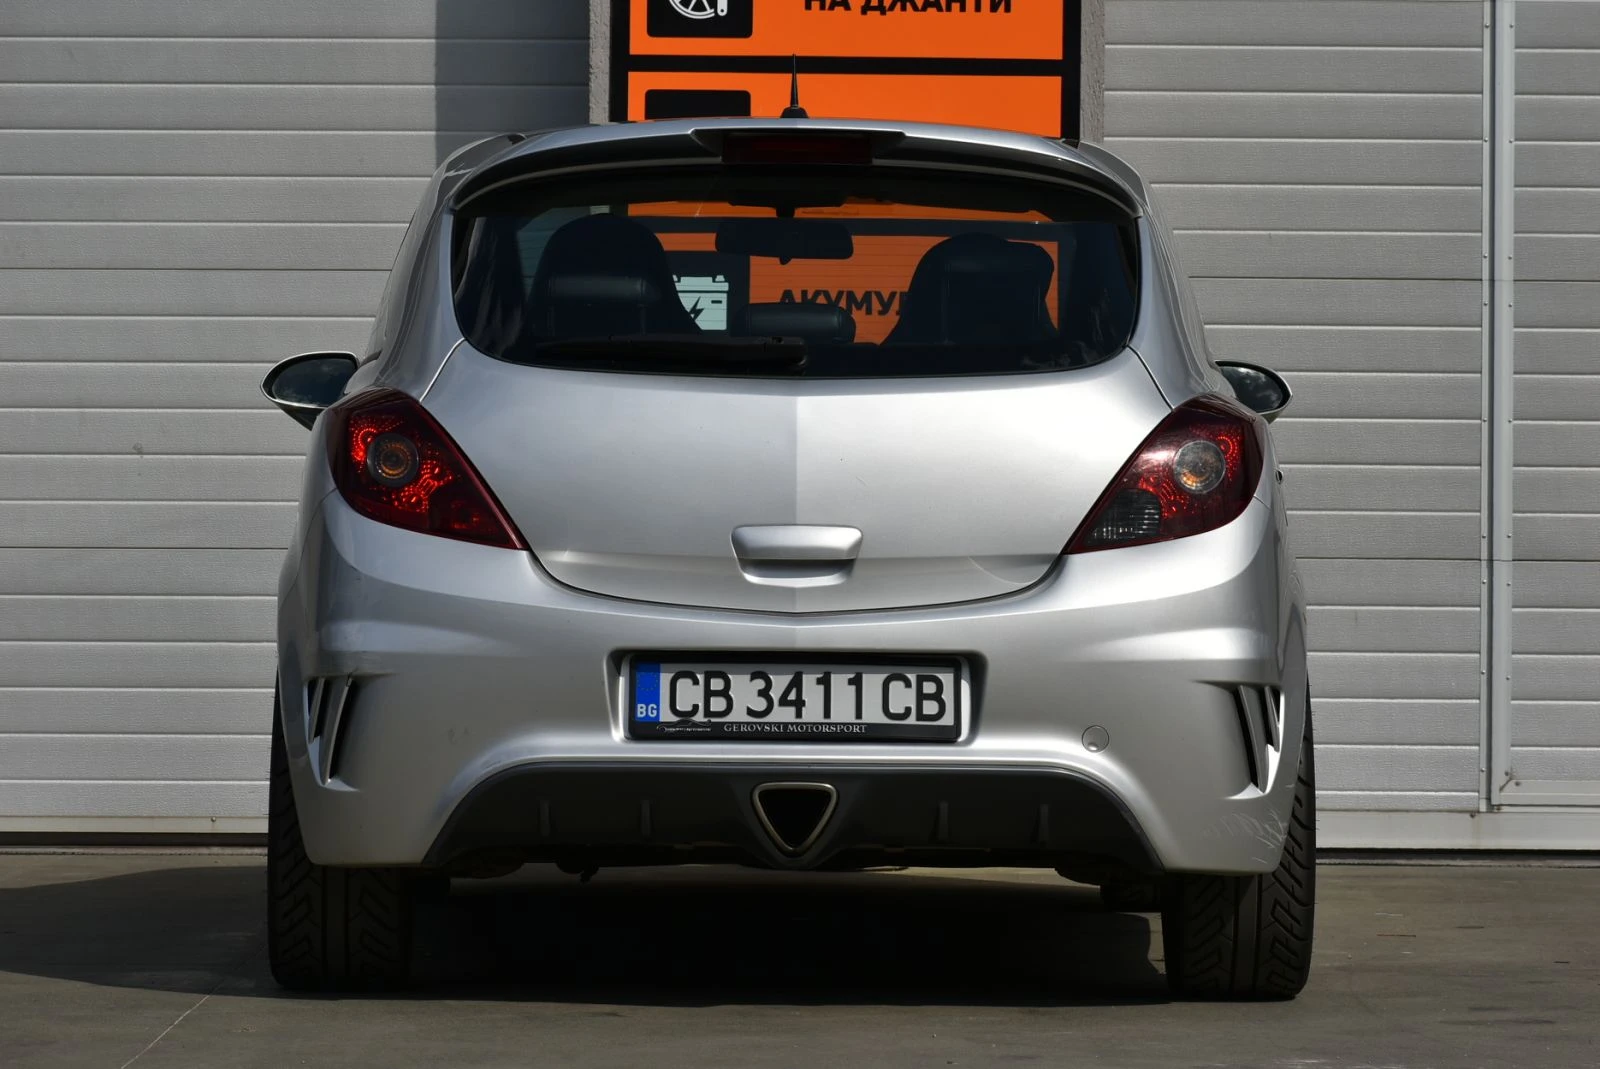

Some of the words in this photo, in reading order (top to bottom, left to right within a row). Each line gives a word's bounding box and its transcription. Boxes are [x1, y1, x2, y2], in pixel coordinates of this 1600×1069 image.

[669, 670, 734, 719] CB
[746, 670, 863, 720] 3411
[882, 672, 946, 722] CB
[636, 703, 657, 718] BG
[723, 723, 785, 733] GEROVSKI
[787, 723, 868, 734] MOTORSPORT
